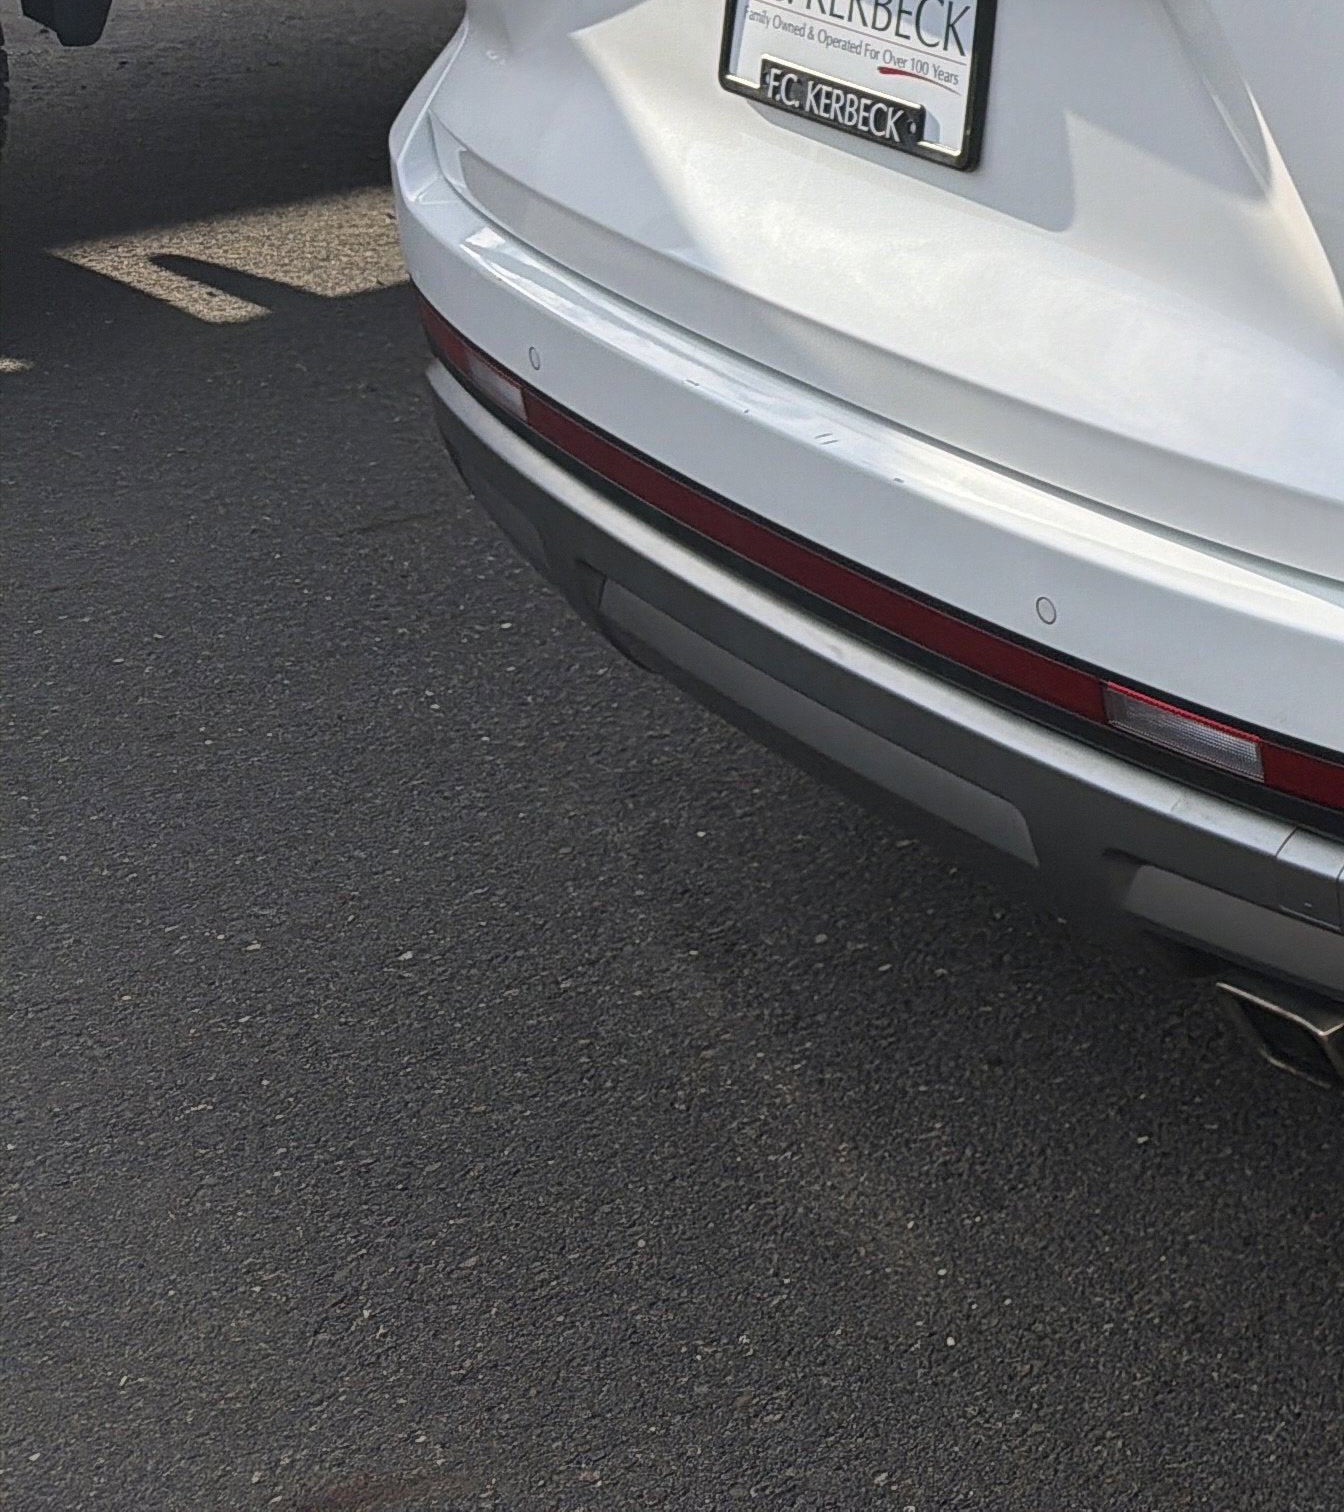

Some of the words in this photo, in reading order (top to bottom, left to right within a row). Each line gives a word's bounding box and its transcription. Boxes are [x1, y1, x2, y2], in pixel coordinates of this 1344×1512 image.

[773, 14, 805, 37] Owned
[807, 26, 815, 41] &
[817, 28, 863, 55] Operated
[864, 43, 880, 60] For
[883, 49, 908, 69] Over
[911, 57, 929, 75] 100
[932, 63, 959, 85] Years
[767, 68, 800, 108] F.C.
[804, 81, 905, 142] KERBECK
